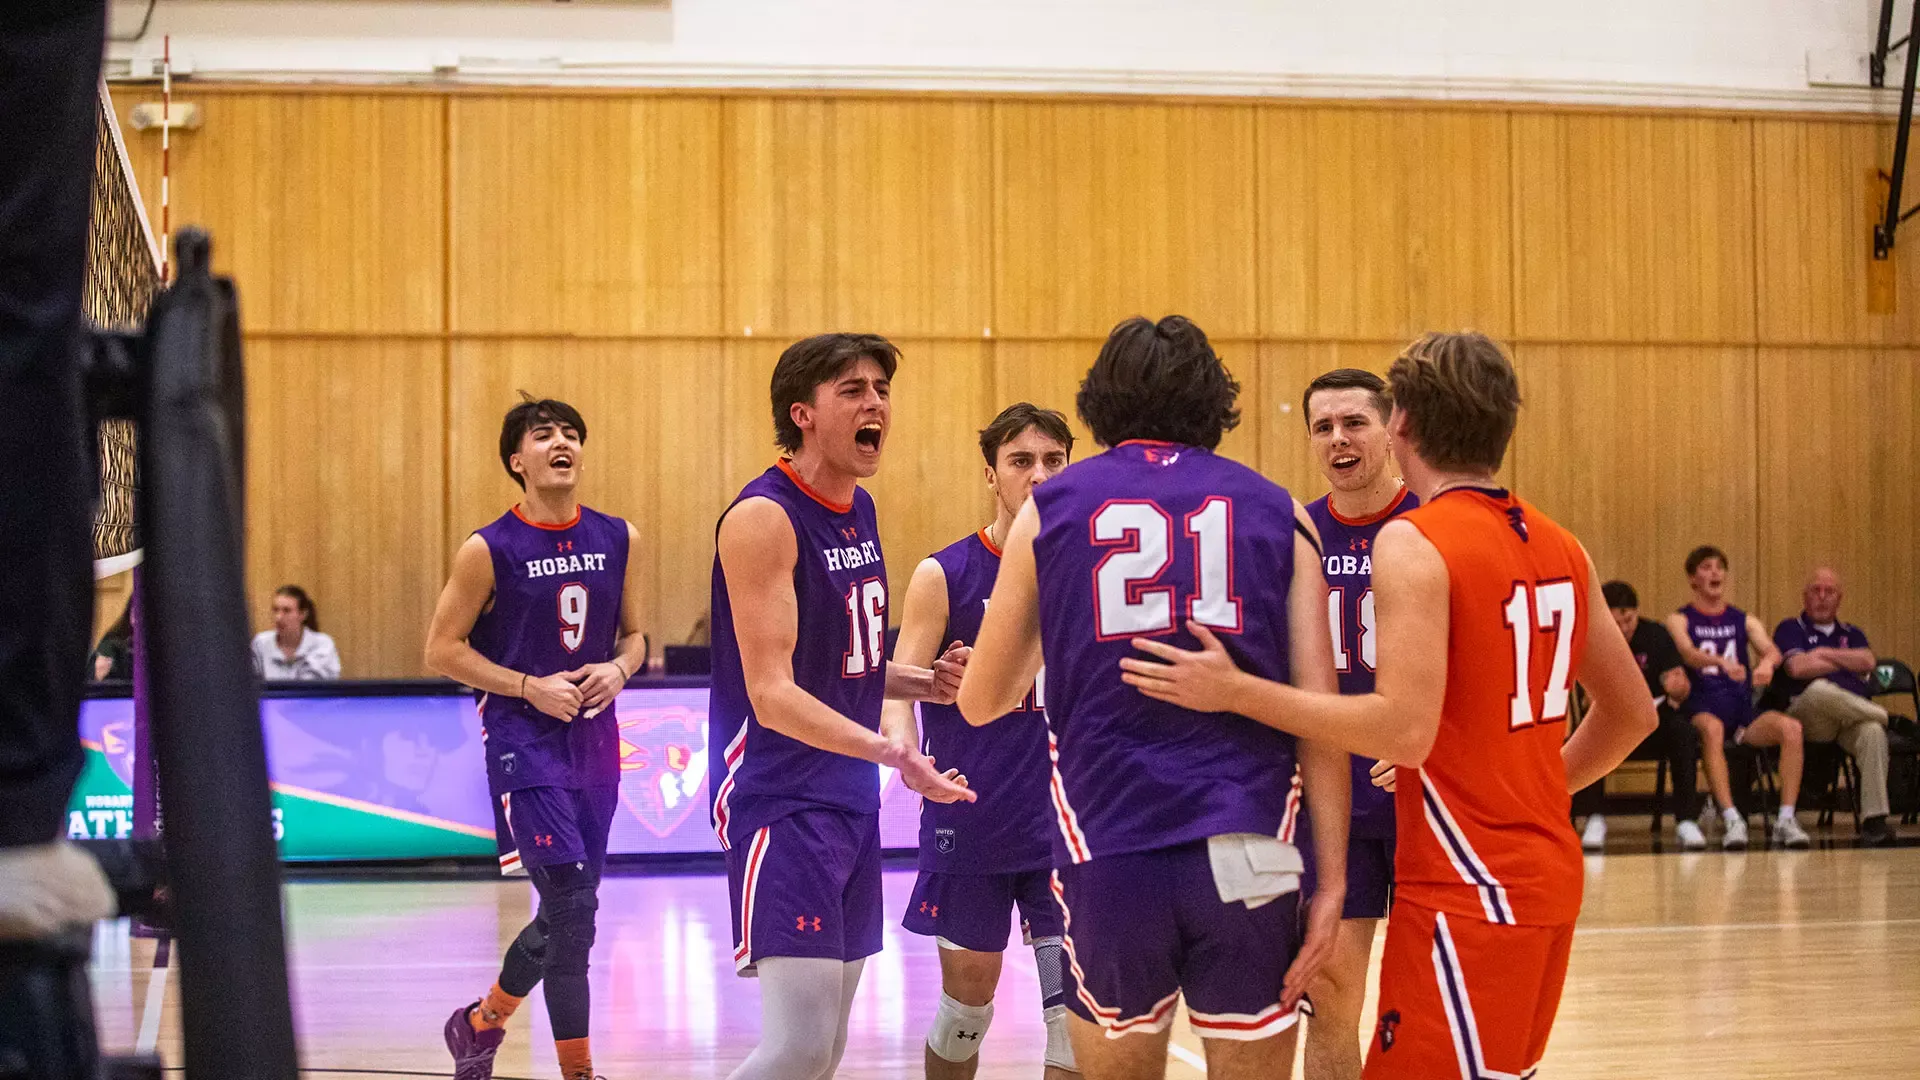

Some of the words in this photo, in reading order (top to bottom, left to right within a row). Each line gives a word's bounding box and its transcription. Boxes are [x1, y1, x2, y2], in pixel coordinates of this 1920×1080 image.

[527, 553, 606, 578] HOBART
[823, 540, 880, 571] HOBART
[1089, 495, 1243, 642] 21
[557, 581, 589, 653] 9
[841, 576, 886, 679] 16
[1501, 576, 1576, 732] 17
